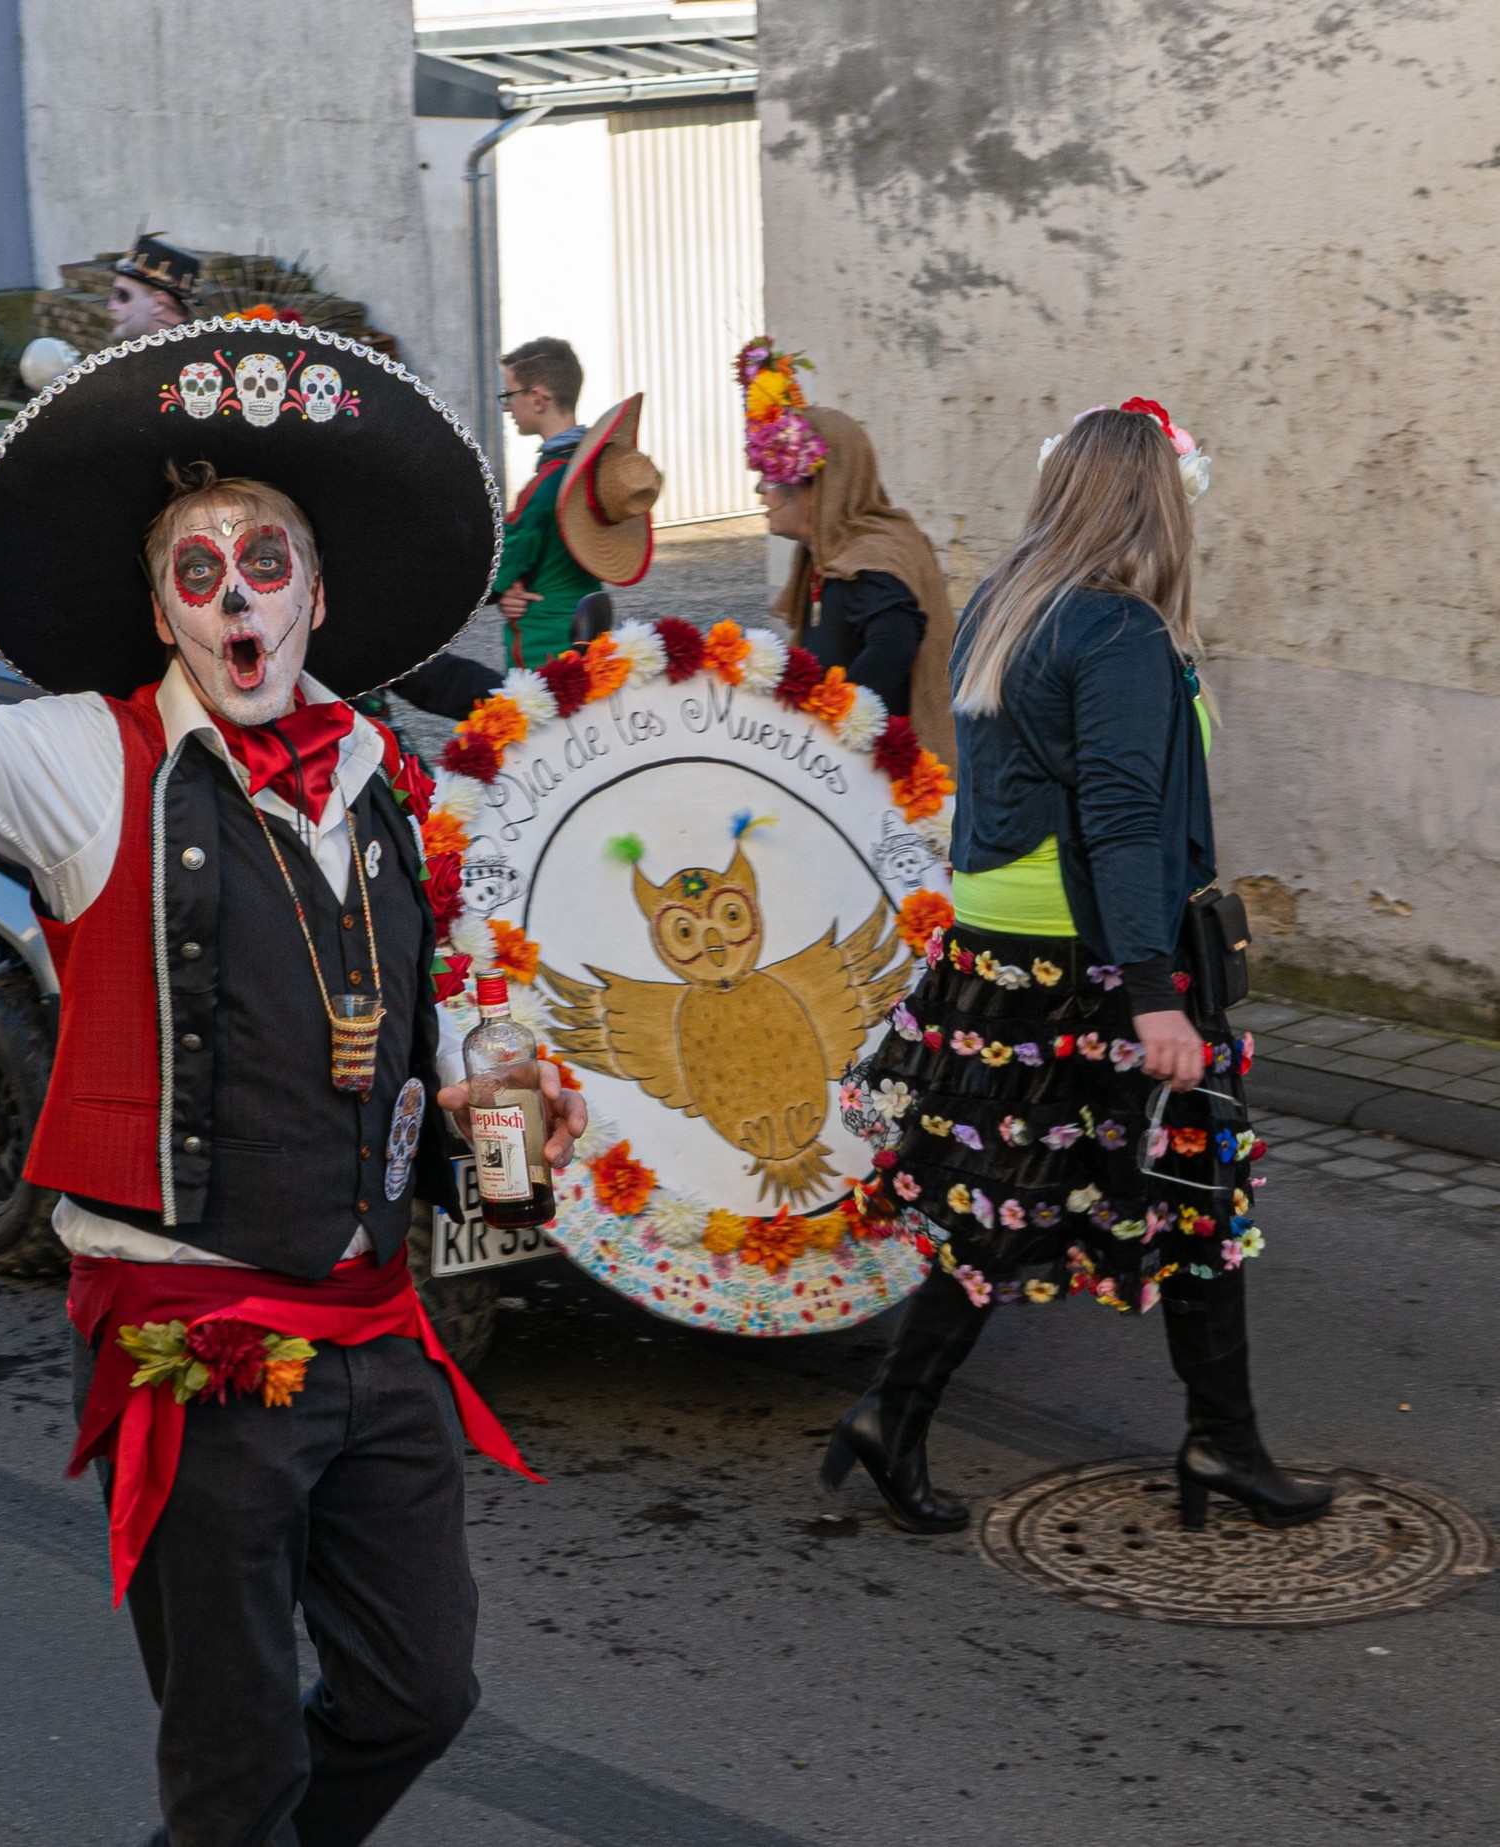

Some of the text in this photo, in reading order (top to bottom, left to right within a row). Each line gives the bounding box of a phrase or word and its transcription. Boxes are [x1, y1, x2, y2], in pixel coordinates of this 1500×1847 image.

[564, 718, 611, 769] de
[610, 691, 668, 746] los
[680, 678, 849, 795] Muertos
[444, 1215, 556, 1265] KR 33
